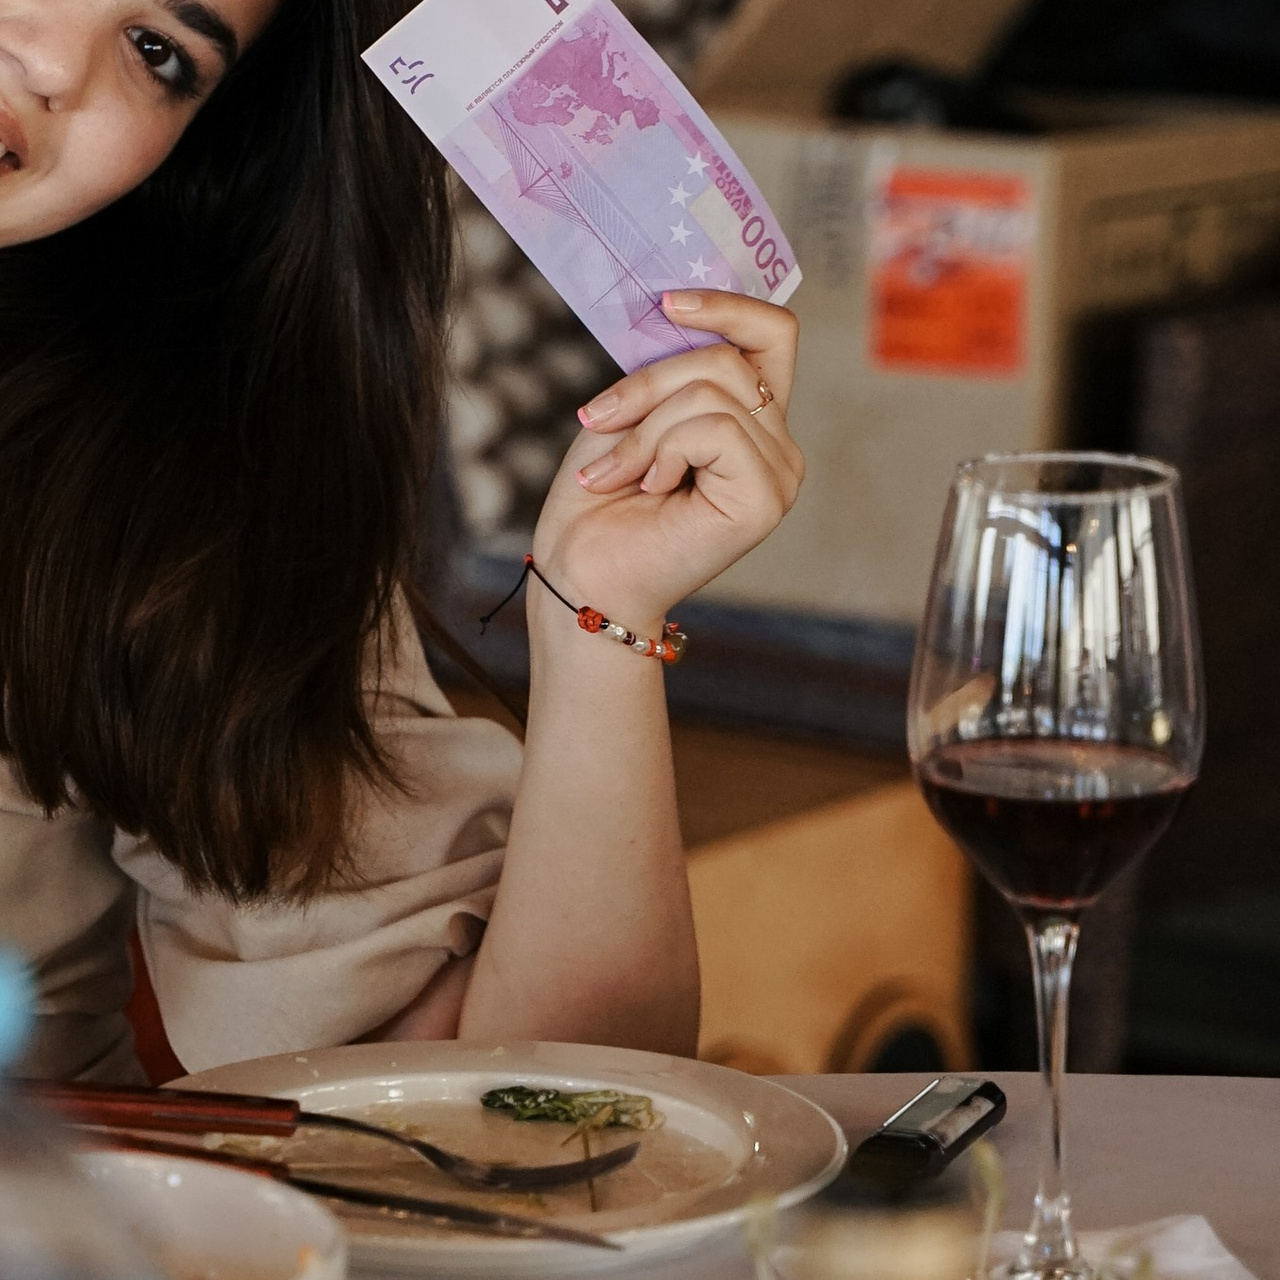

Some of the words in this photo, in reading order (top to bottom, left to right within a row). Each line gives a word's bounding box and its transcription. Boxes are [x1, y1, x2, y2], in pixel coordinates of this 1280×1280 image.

[465, 102, 475, 112] НЕ
[474, 77, 503, 105] ЯВЛЯЕТСЯ
[502, 48, 536, 80] ПЛАТЕЖНЫМ
[534, 20, 564, 50] СРЕДСТВОМ
[715, 177, 748, 221] EURO
[742, 215, 788, 292] 500
